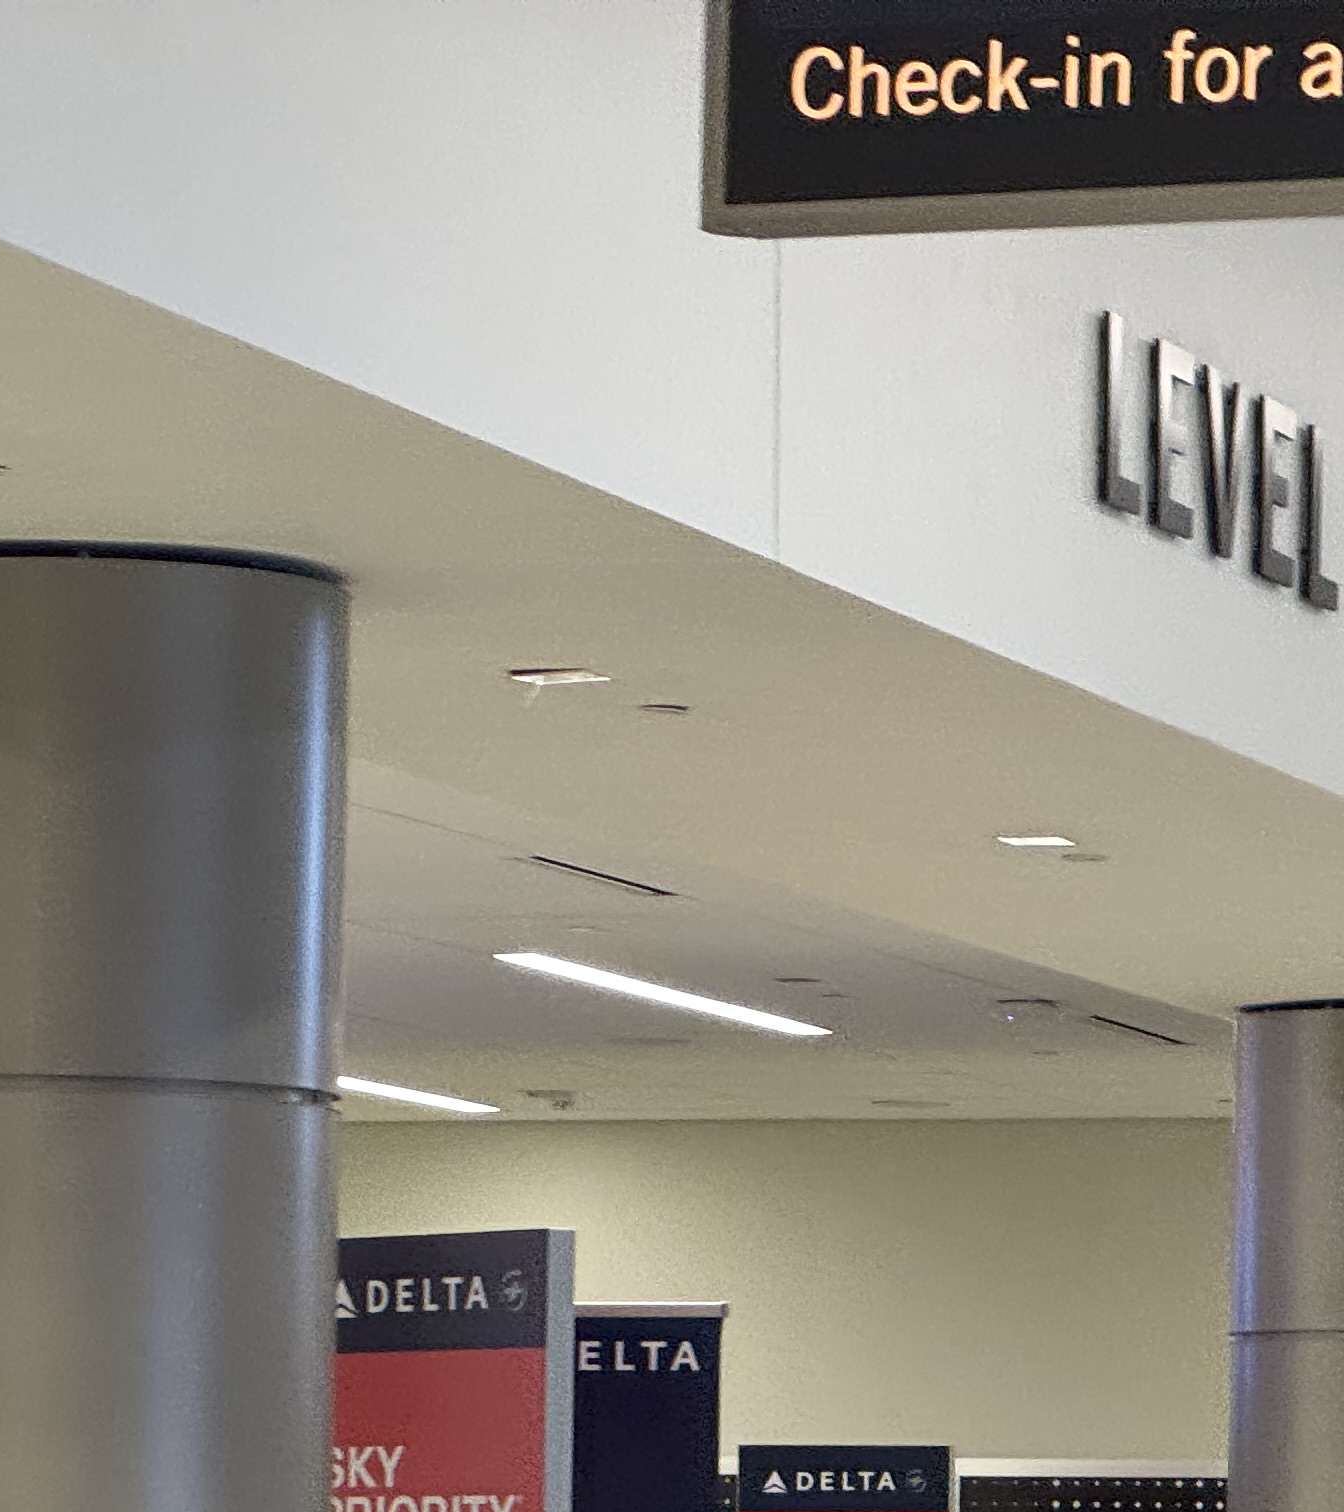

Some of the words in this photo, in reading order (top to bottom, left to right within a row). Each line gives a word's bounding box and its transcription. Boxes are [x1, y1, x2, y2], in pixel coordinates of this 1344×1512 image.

[791, 33, 1132, 120] Check-in
[1164, 28, 1273, 104] for
[1097, 310, 1339, 612] LEVEL
[365, 1275, 489, 1314] DELTA
[577, 1339, 701, 1372] ELTA
[795, 1471, 896, 1492] DELTA
